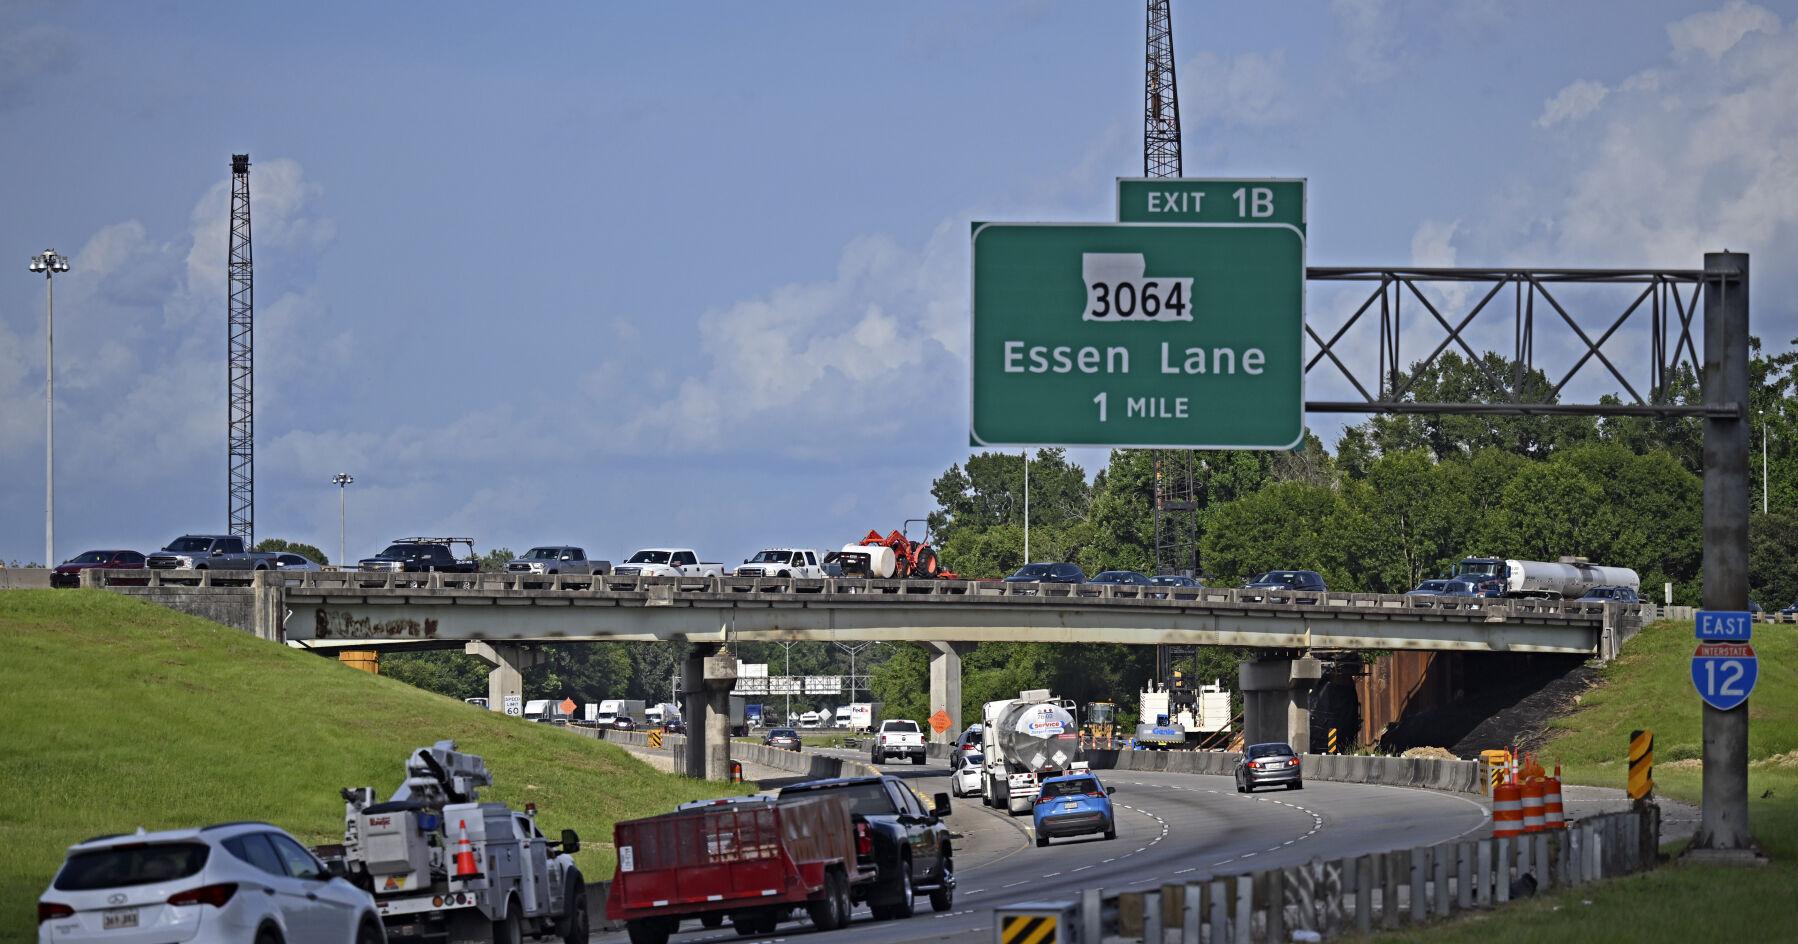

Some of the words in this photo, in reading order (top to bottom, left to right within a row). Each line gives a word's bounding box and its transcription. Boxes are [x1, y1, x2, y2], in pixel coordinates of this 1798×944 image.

[1147, 191, 1206, 213] EXIT
[1232, 187, 1275, 218] 1B
[1091, 281, 1187, 318] 3064
[1004, 340, 1130, 374] Essen
[1160, 341, 1266, 375] Lane
[1093, 392, 1108, 422] 1
[1126, 397, 1190, 418] MILE
[1702, 615, 1745, 635] EAST
[1701, 647, 1747, 656] INTERSTATE
[1704, 660, 1744, 696] 12
